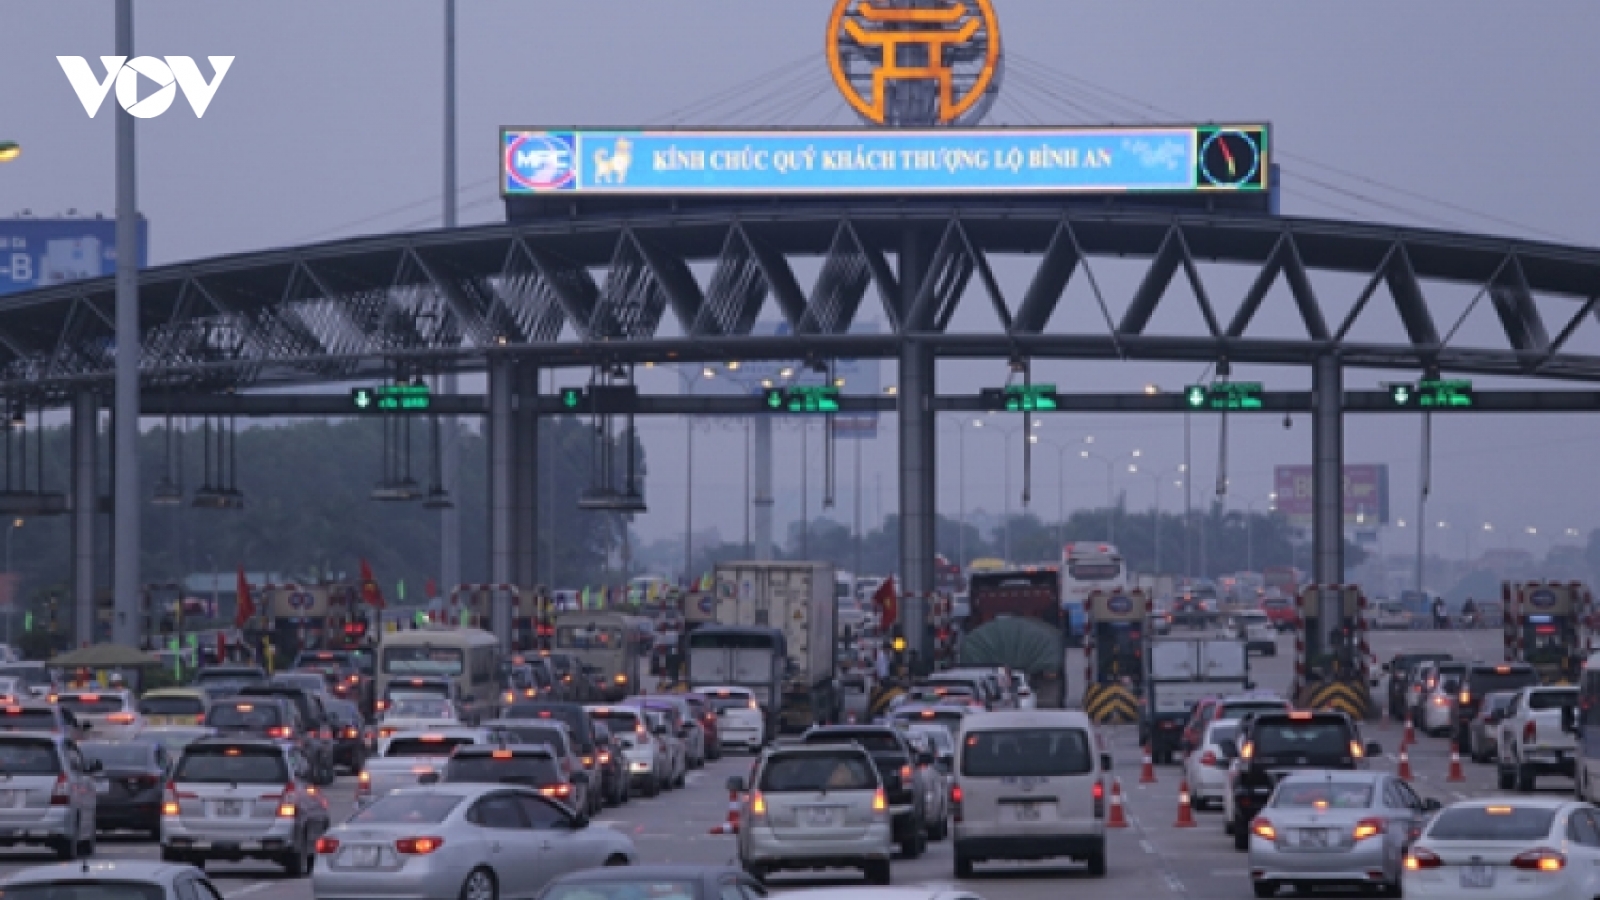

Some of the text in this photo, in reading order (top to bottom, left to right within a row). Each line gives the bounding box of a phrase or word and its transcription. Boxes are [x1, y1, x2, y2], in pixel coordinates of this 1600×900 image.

[652, 143, 1113, 174] KÍNH CHÚC QUÝ KHÁCH THƯỢNG LỘ BÌNH AN
